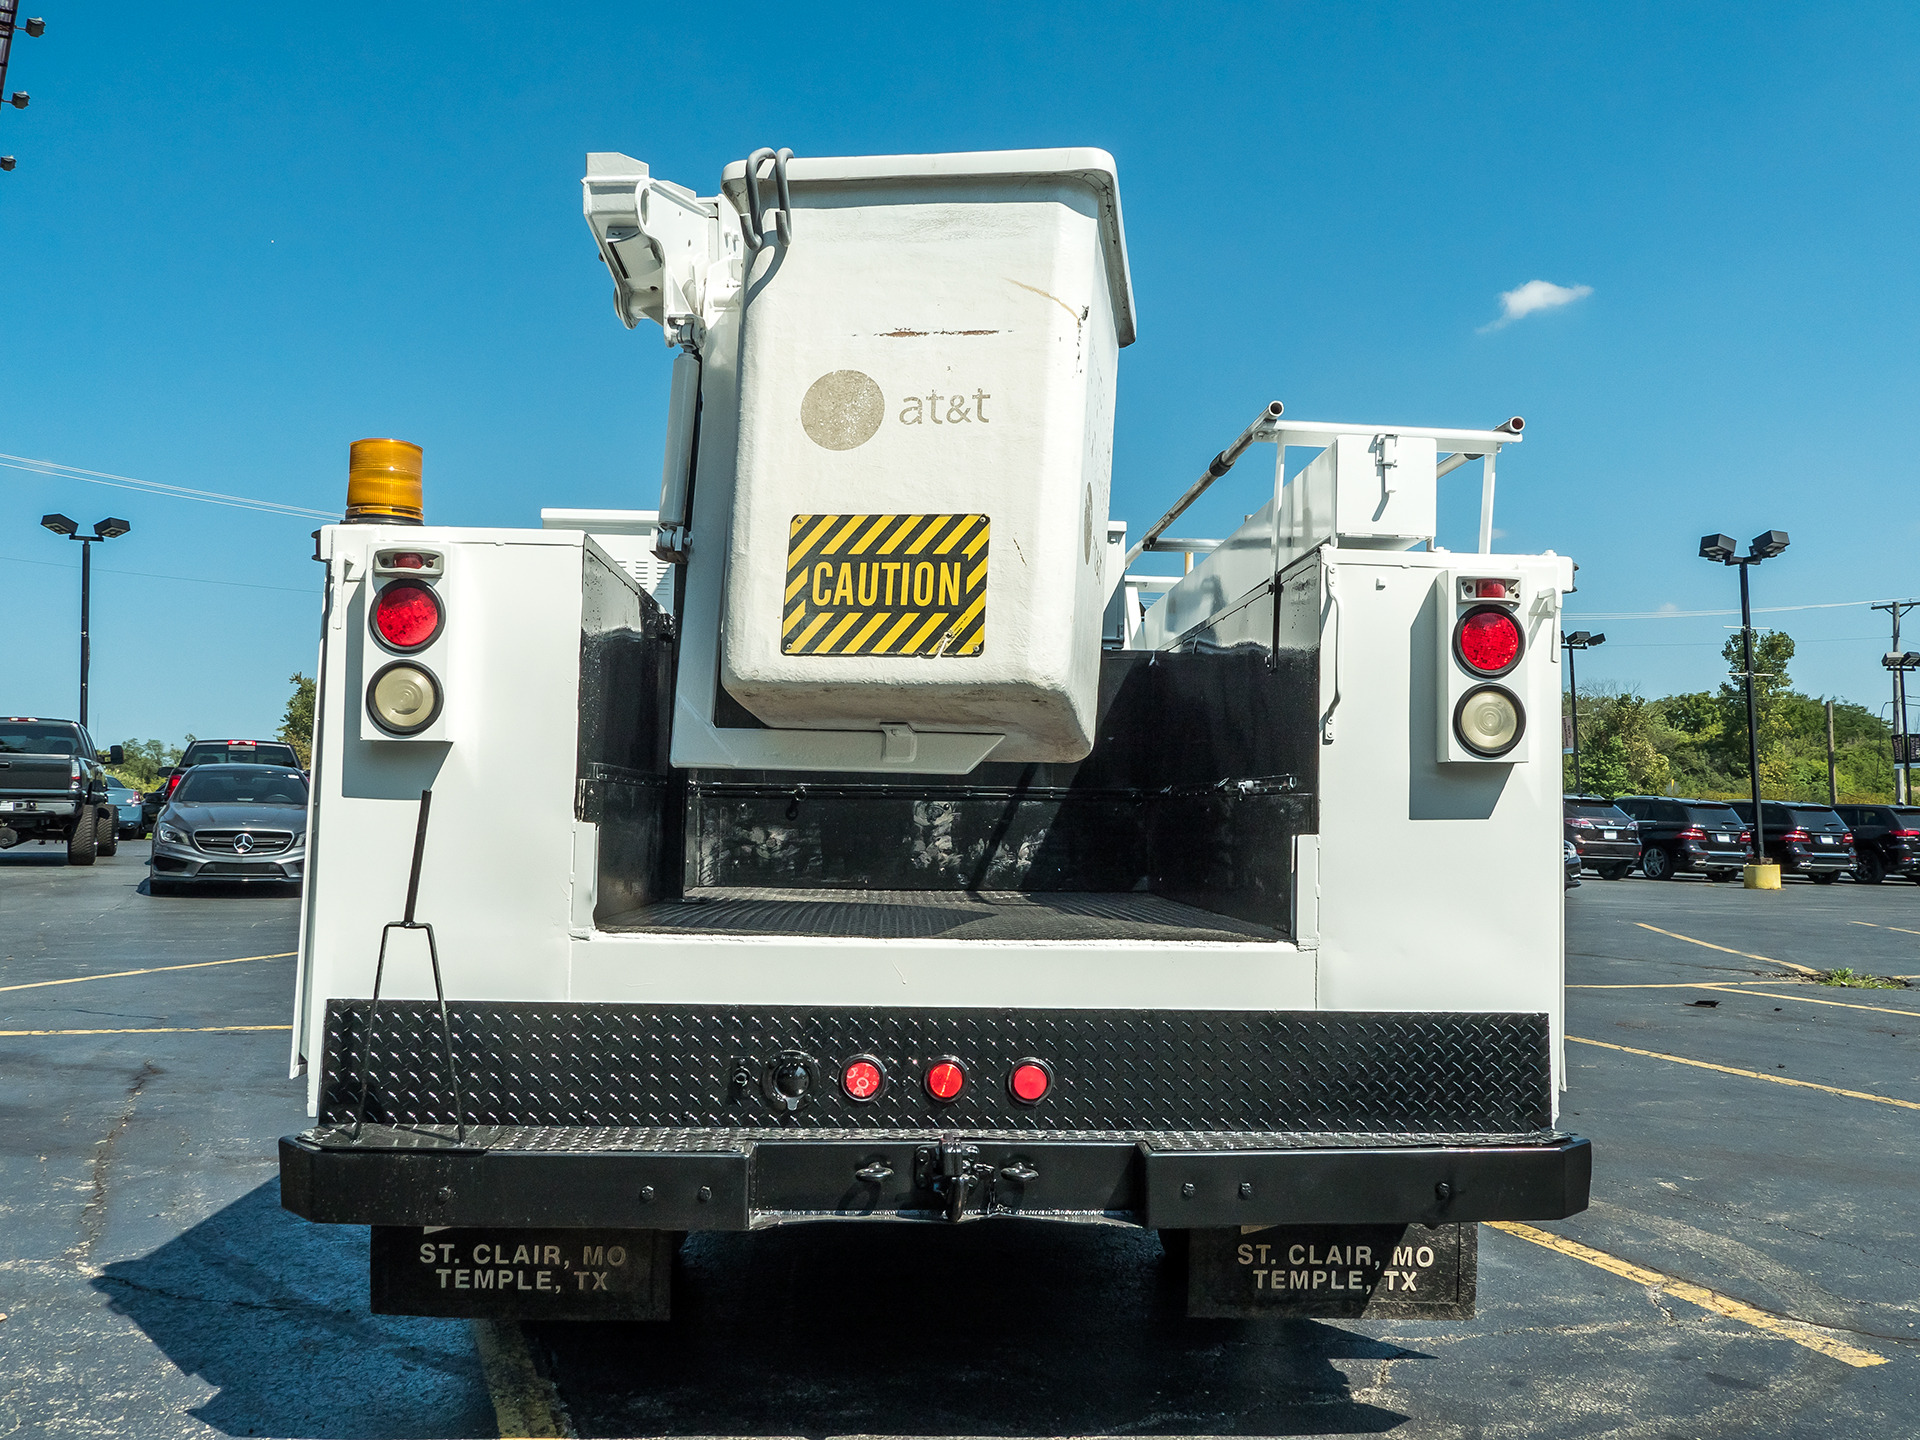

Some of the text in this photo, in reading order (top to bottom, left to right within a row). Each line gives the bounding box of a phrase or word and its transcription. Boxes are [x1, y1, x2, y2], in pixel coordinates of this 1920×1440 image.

[899, 388, 991, 425] at&t
[812, 561, 961, 606] CAUTION
[420, 1243, 627, 1269] ST. CLAIR, MO
[1237, 1243, 1434, 1270] ST. CLAIR, MO
[435, 1268, 609, 1293] TEMPLE, TX
[1252, 1269, 1418, 1295] TEMPLE, TX
